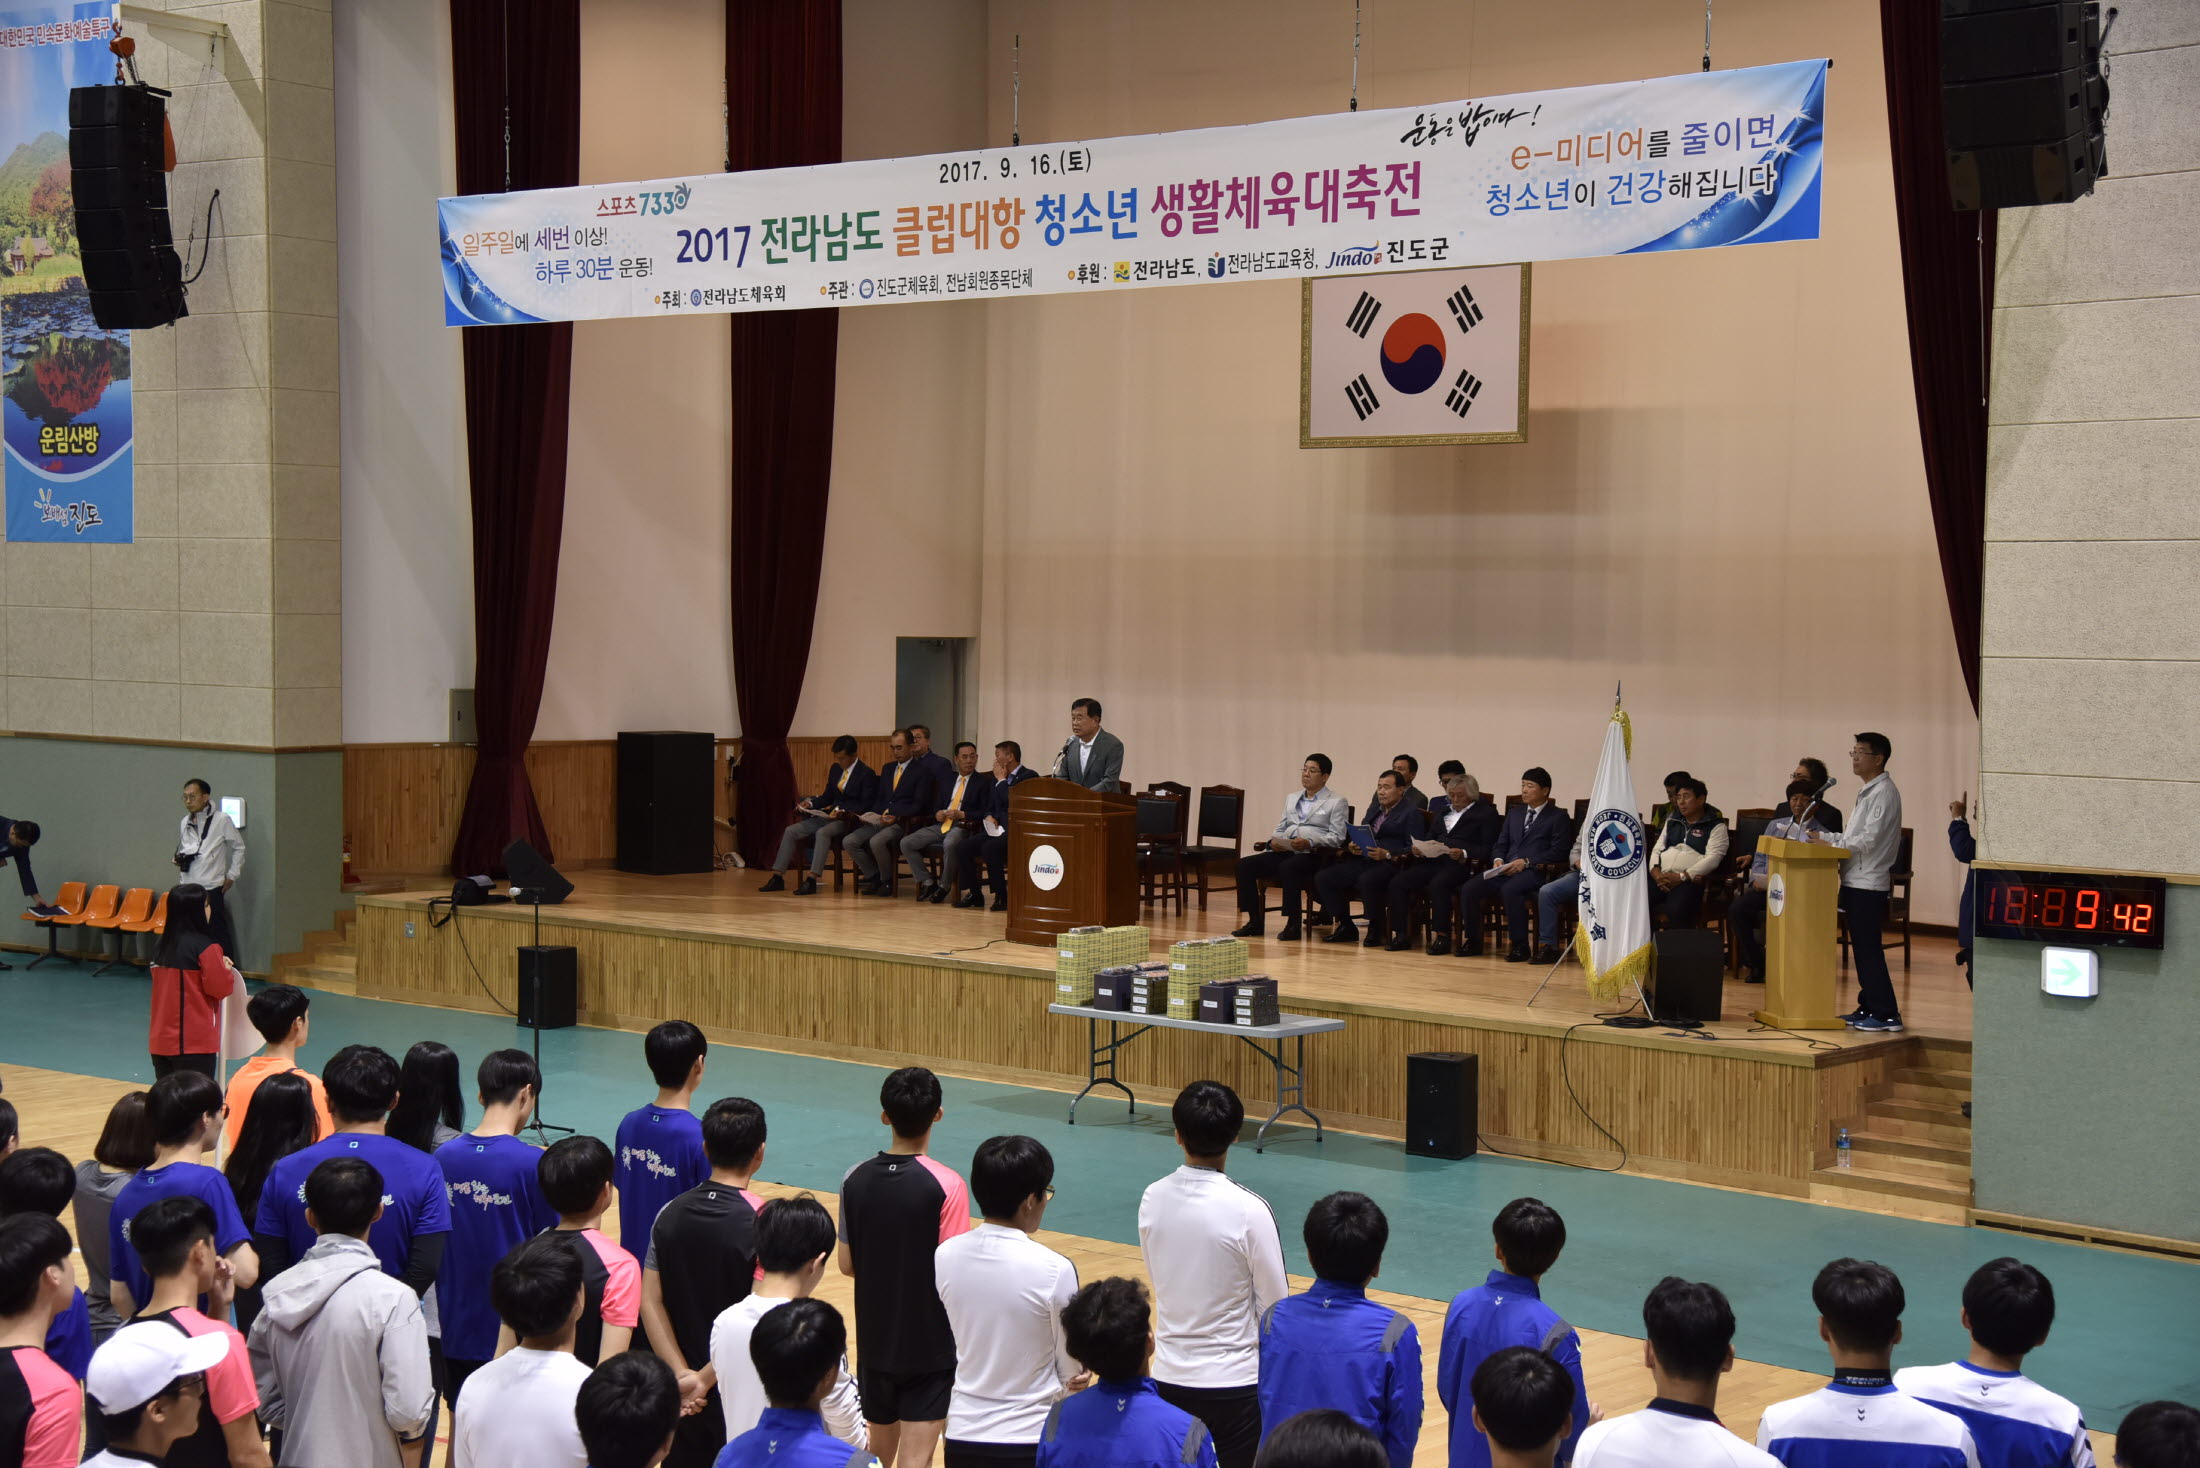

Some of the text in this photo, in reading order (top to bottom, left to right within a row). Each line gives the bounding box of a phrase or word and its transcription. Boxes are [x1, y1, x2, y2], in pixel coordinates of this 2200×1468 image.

[0, 26, 35, 48] 대한민국
[1510, 113, 1777, 171] e-미디어를 줄이면
[940, 147, 1093, 184] 2017. 9. 16.(토)
[1486, 161, 1776, 217] 청소년이 건강해집니다
[675, 159, 1422, 270] 2017 전라남도 클럽대항 청소년 생활체육대축전
[462, 226, 608, 257] 일주일에 세번 이상!
[1325, 245, 1374, 269] Jindo
[1386, 237, 1450, 264] 진도군
[534, 256, 653, 285] 하루 30분 운동!
[703, 284, 787, 306] 전라남도체육회
[876, 273, 943, 298] 진도군체육회,
[946, 268, 1034, 295] 전남회원종목단체
[1133, 256, 1202, 283] 전라남도,
[1228, 247, 1319, 276] 전라남도교육청,
[39, 426, 99, 454] 운림산방
[69, 500, 103, 534] 진도
[1607, 857, 1640, 876] COUNCIL
